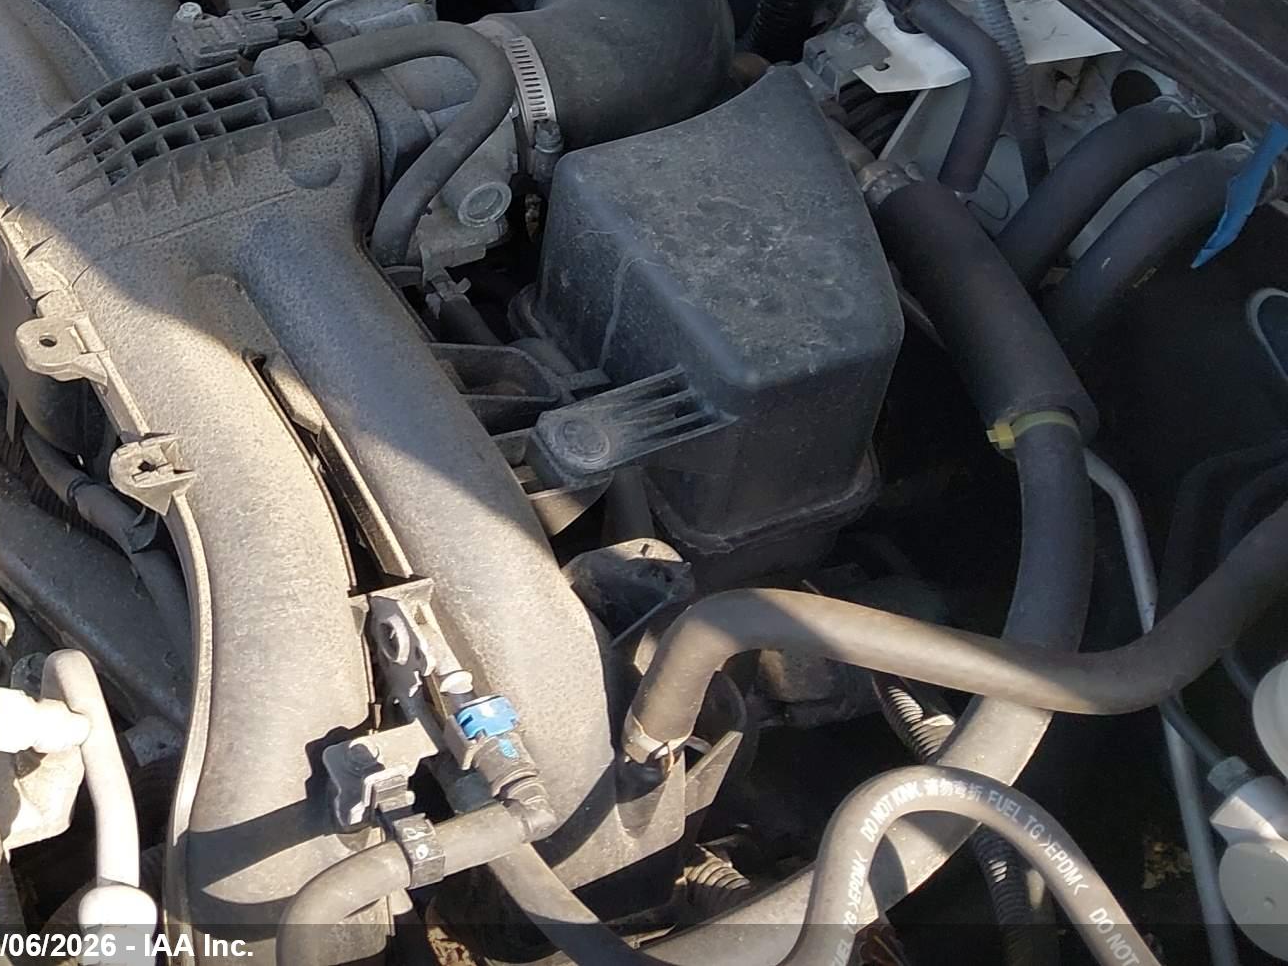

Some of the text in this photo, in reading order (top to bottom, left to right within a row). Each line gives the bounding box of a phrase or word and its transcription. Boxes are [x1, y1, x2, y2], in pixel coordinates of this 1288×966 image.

[861, 818, 878, 842] DO
[871, 795, 895, 824] NOT
[987, 791, 1022, 823] FUEL
[1024, 815, 1046, 840] TG
[1089, 907, 1115, 934] DO
[1106, 933, 1140, 966] NOT
